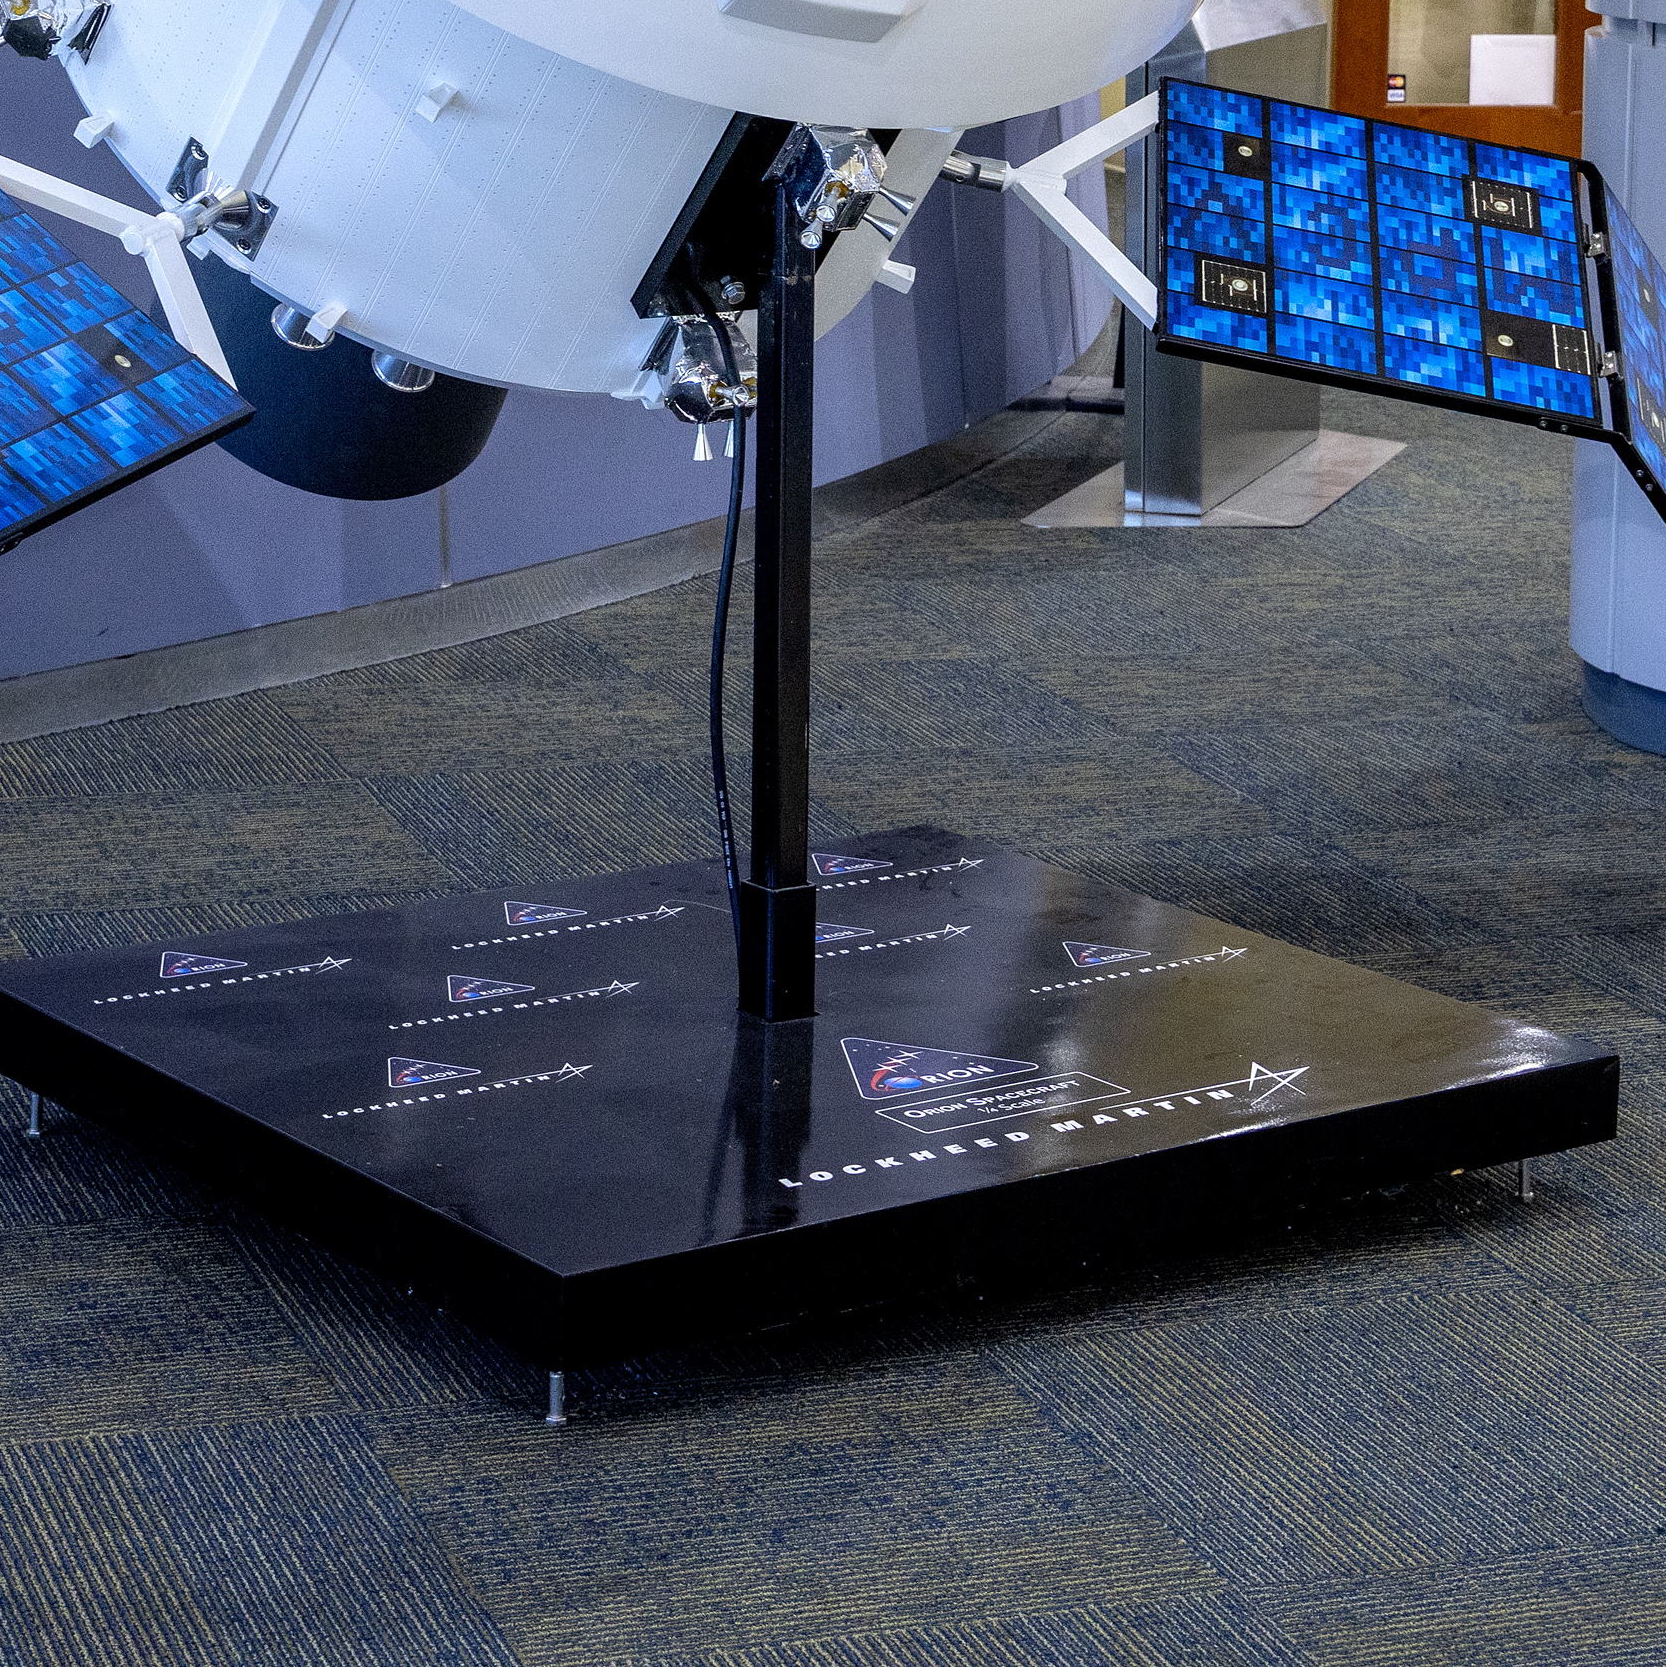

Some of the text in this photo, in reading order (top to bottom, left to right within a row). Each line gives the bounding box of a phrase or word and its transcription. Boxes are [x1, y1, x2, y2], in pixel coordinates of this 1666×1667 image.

[452, 915, 649, 950] LOCKHEED MARTIN
[858, 934, 938, 951] MARTIN
[93, 967, 311, 1005] LOCKHEED MARTIN
[1030, 956, 1216, 994] LOCKHEED MARTIN
[388, 991, 600, 1030] LOCKHEED MARTIN
[322, 1075, 551, 1119] LOCKHEED MARTIN
[903, 1080, 1082, 1119] ORION SPACECRAFT
[998, 1096, 1046, 1112] Scale
[778, 1089, 1235, 1189] LOCKHEED MARTIN
